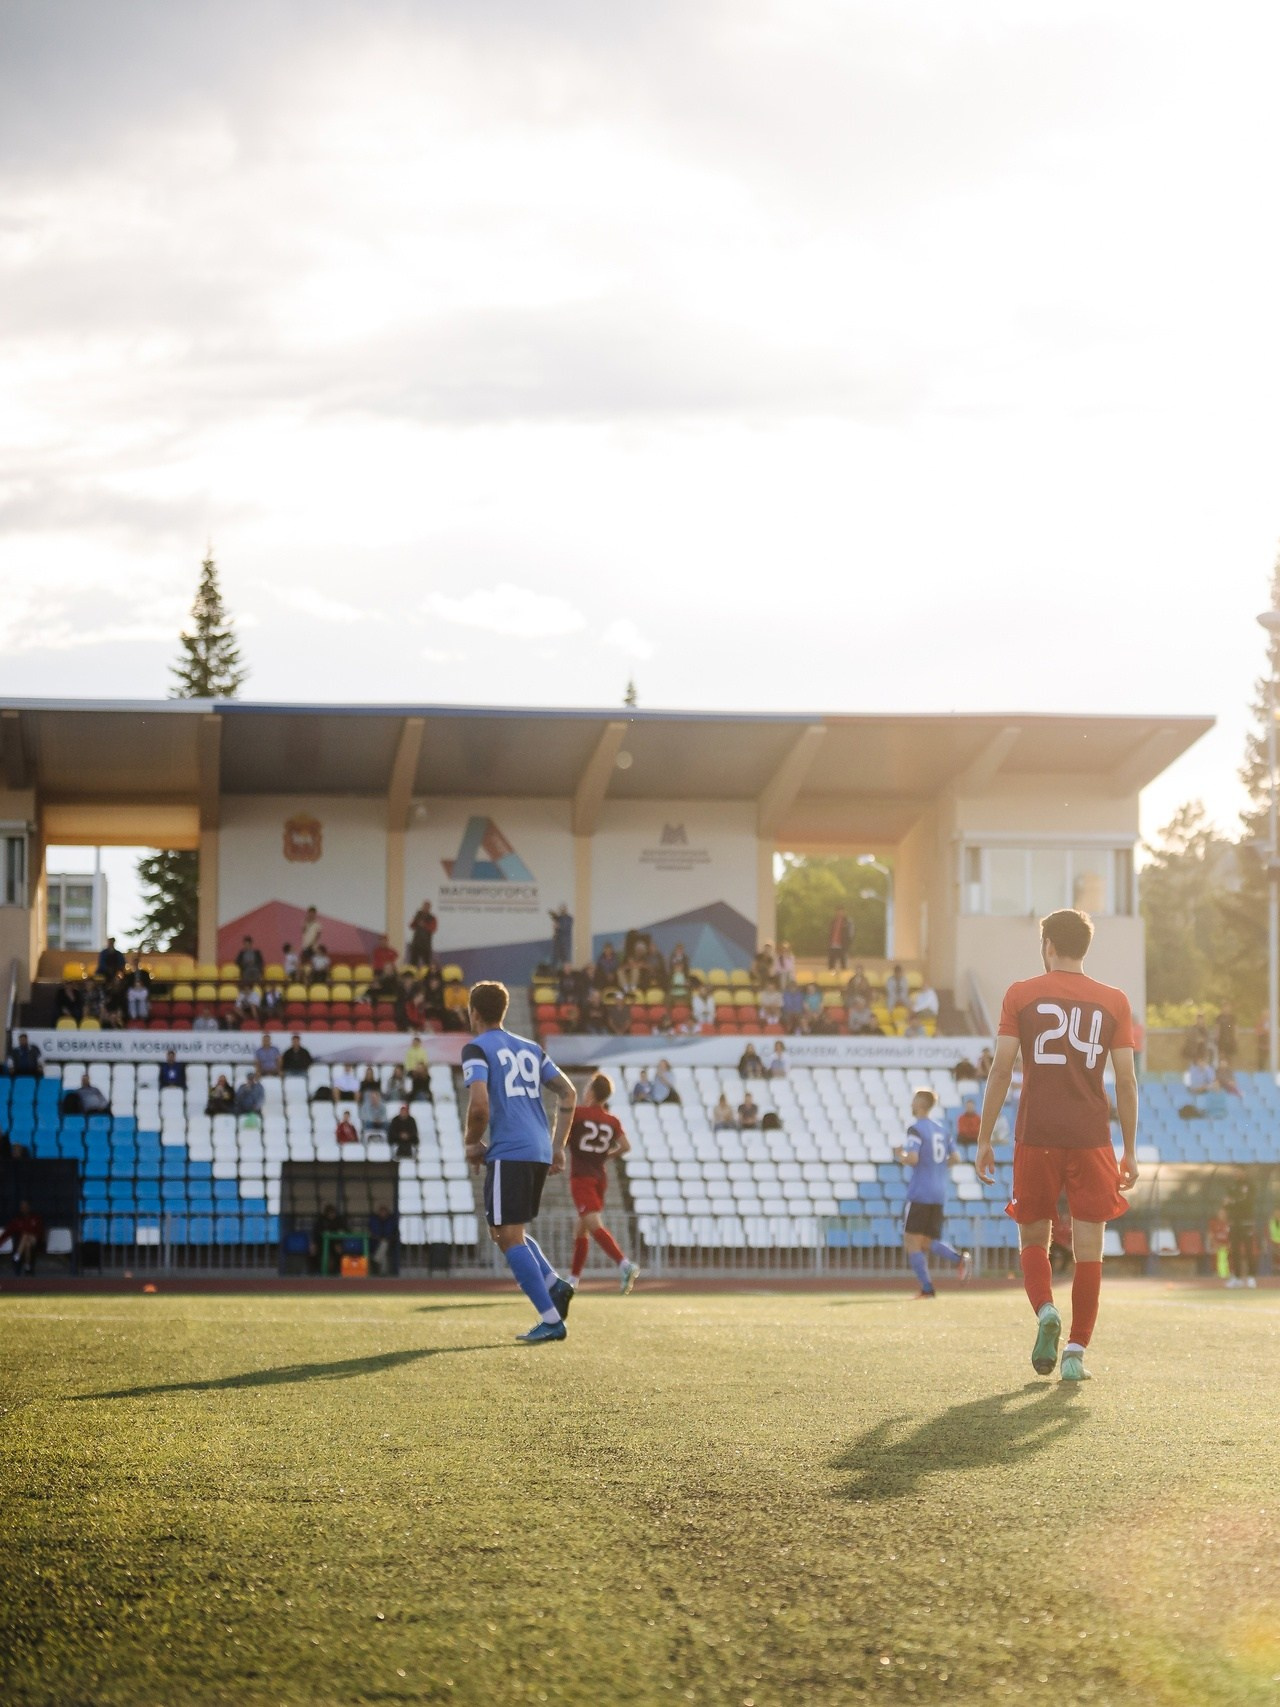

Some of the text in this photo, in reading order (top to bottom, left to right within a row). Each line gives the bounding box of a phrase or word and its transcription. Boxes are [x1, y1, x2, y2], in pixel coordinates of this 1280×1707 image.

[1034, 1003, 1103, 1070] 24
[497, 1048, 540, 1099] 29
[579, 1121, 614, 1153] 23
[932, 1133, 946, 1164] 6
